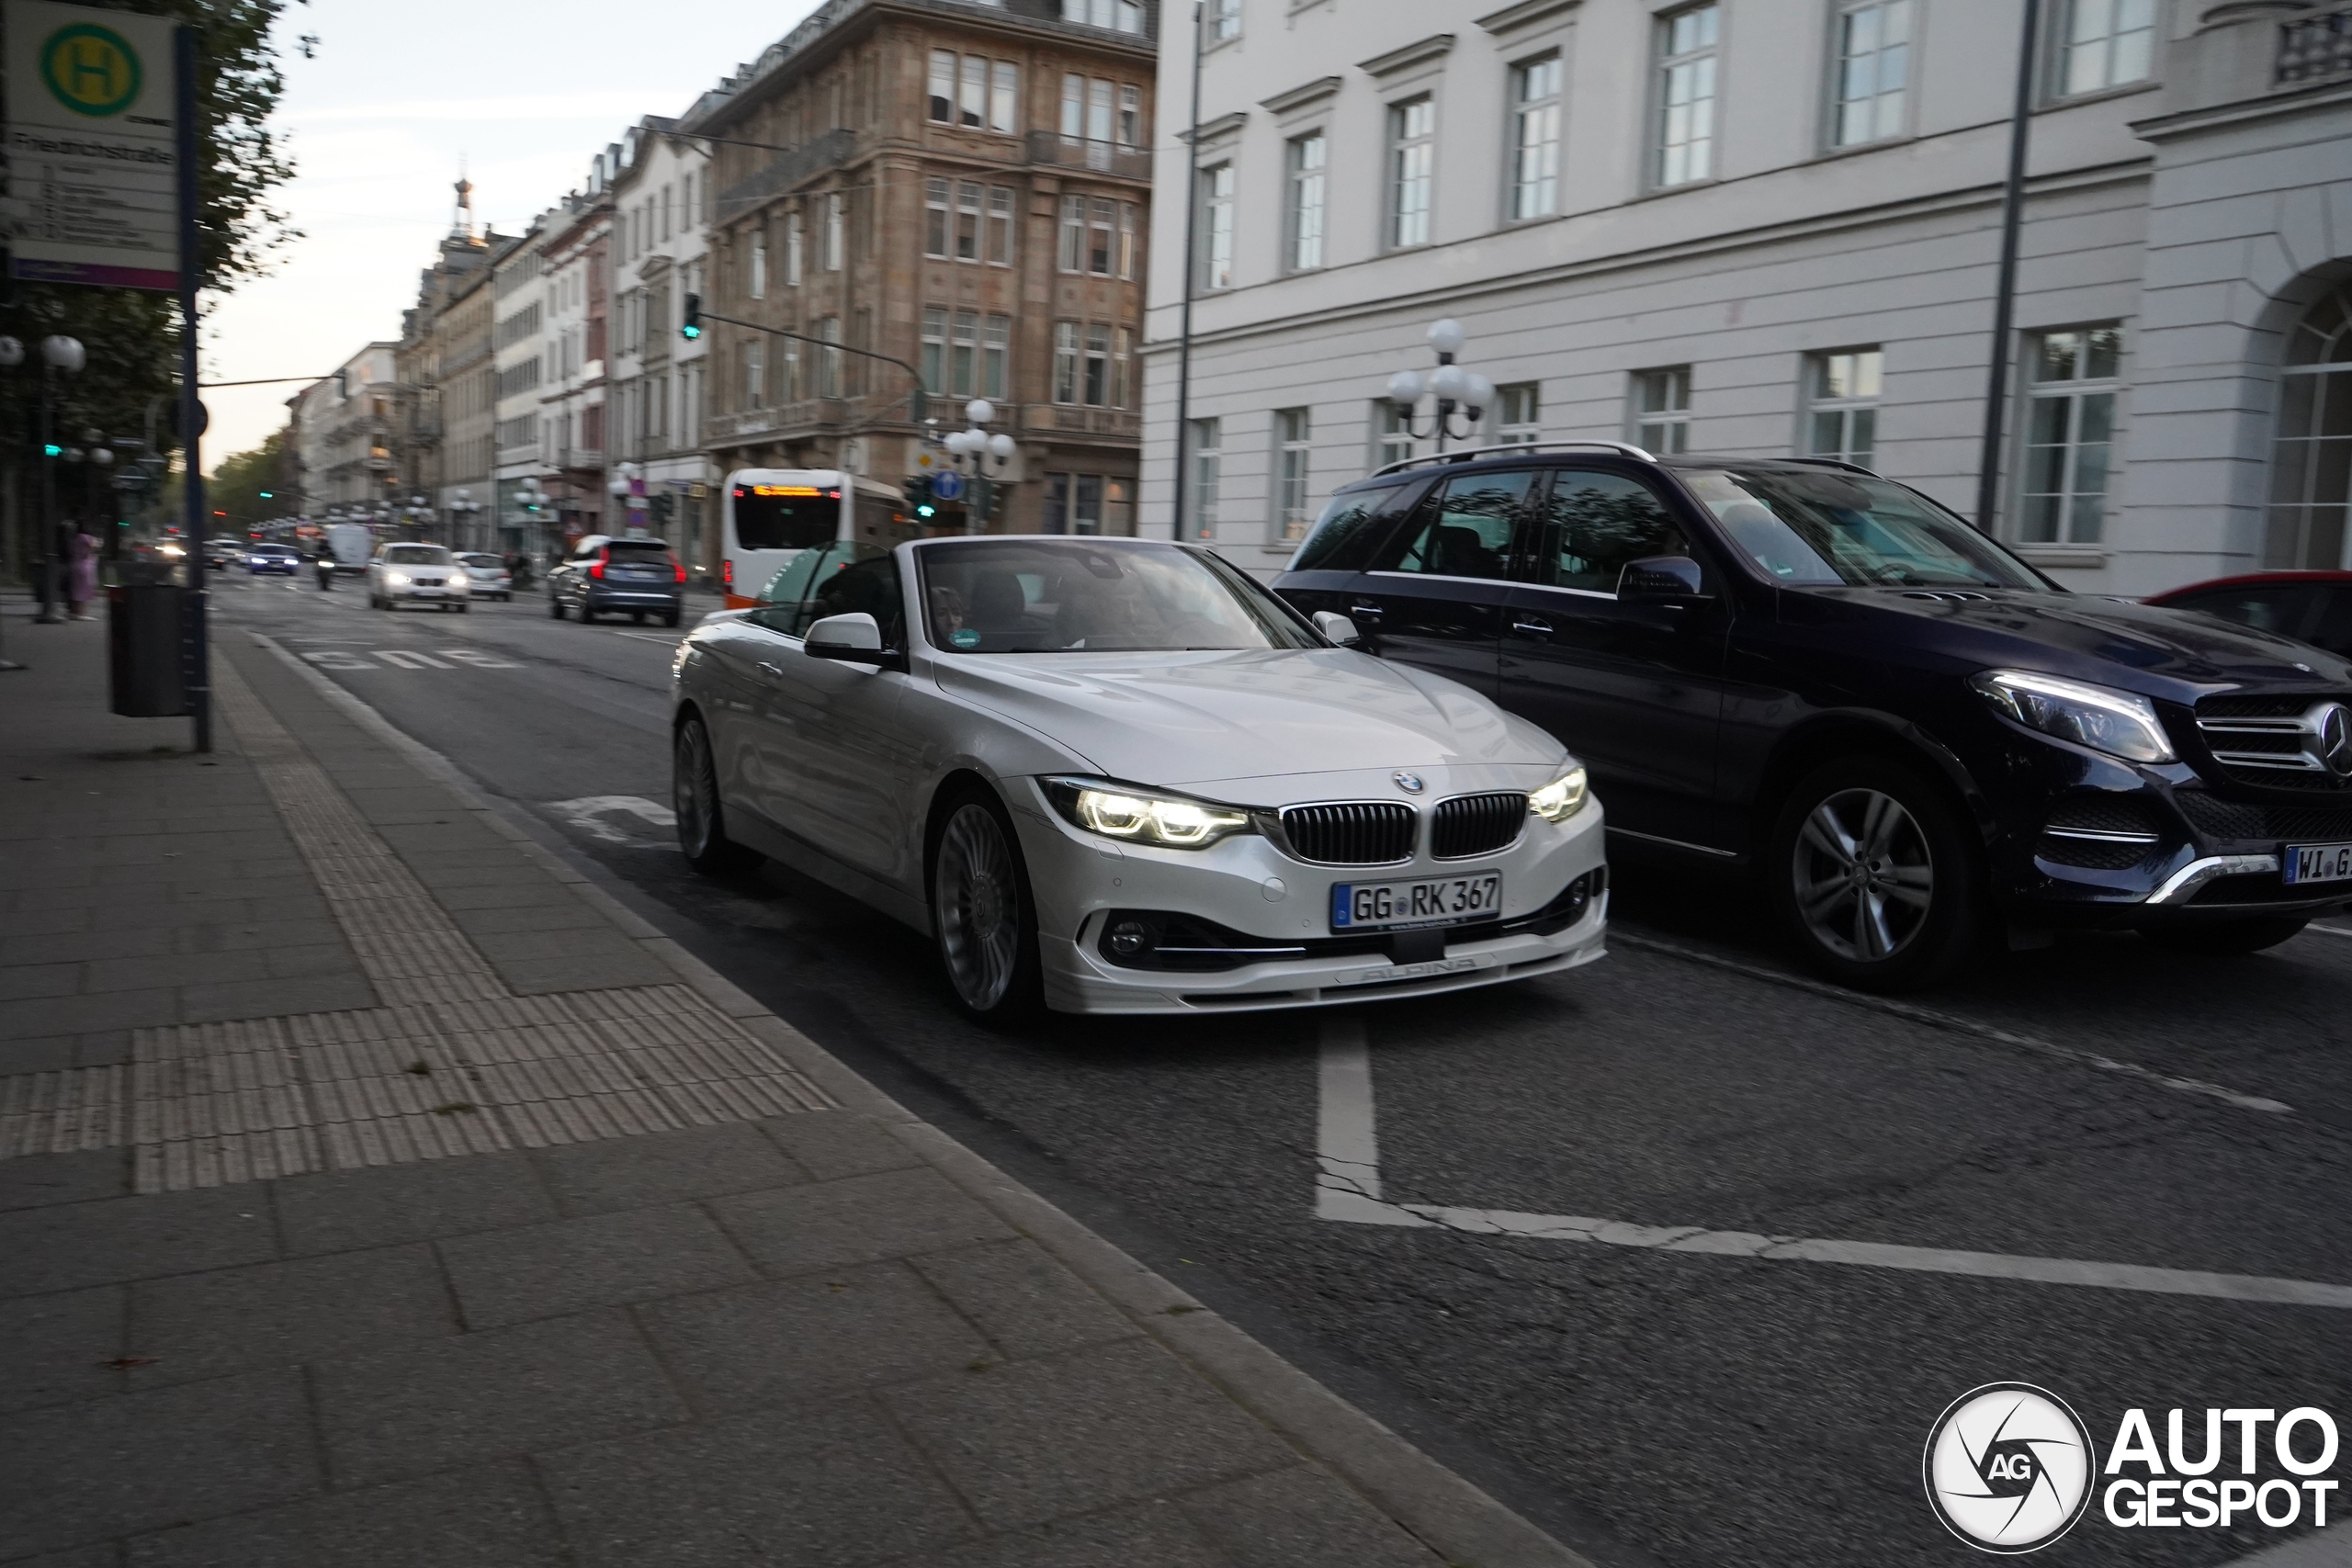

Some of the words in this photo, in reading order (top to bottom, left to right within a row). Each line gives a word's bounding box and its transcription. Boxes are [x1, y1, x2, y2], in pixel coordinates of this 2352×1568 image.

[71, 41, 114, 98] H
[2299, 850, 2324, 879] WI
[2336, 848, 2352, 876] G
[1354, 887, 1392, 920] GG
[1411, 882, 1448, 917] RK
[1452, 877, 1498, 912] 367
[1363, 958, 1477, 980] ALPINA
